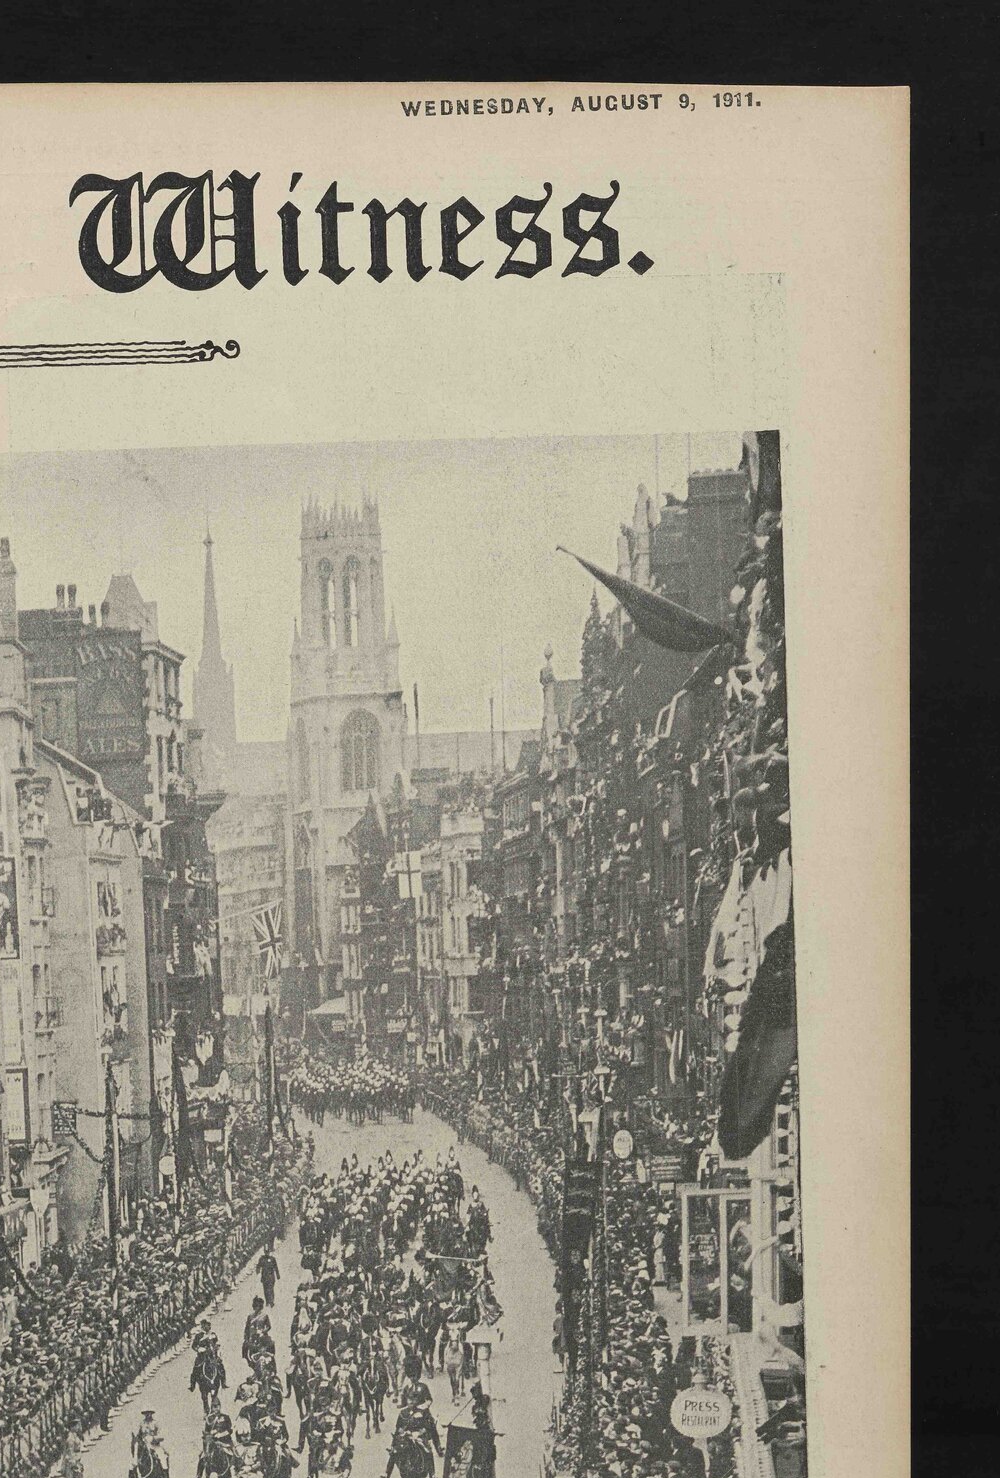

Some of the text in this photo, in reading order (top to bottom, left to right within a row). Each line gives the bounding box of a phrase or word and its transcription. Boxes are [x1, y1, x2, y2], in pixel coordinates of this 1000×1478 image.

[401, 92, 762, 117] WEDNESDAY, AUGUST 9, 1911.
[69, 169, 656, 294] Witness.
[684, 1400, 720, 1412] PRESS
